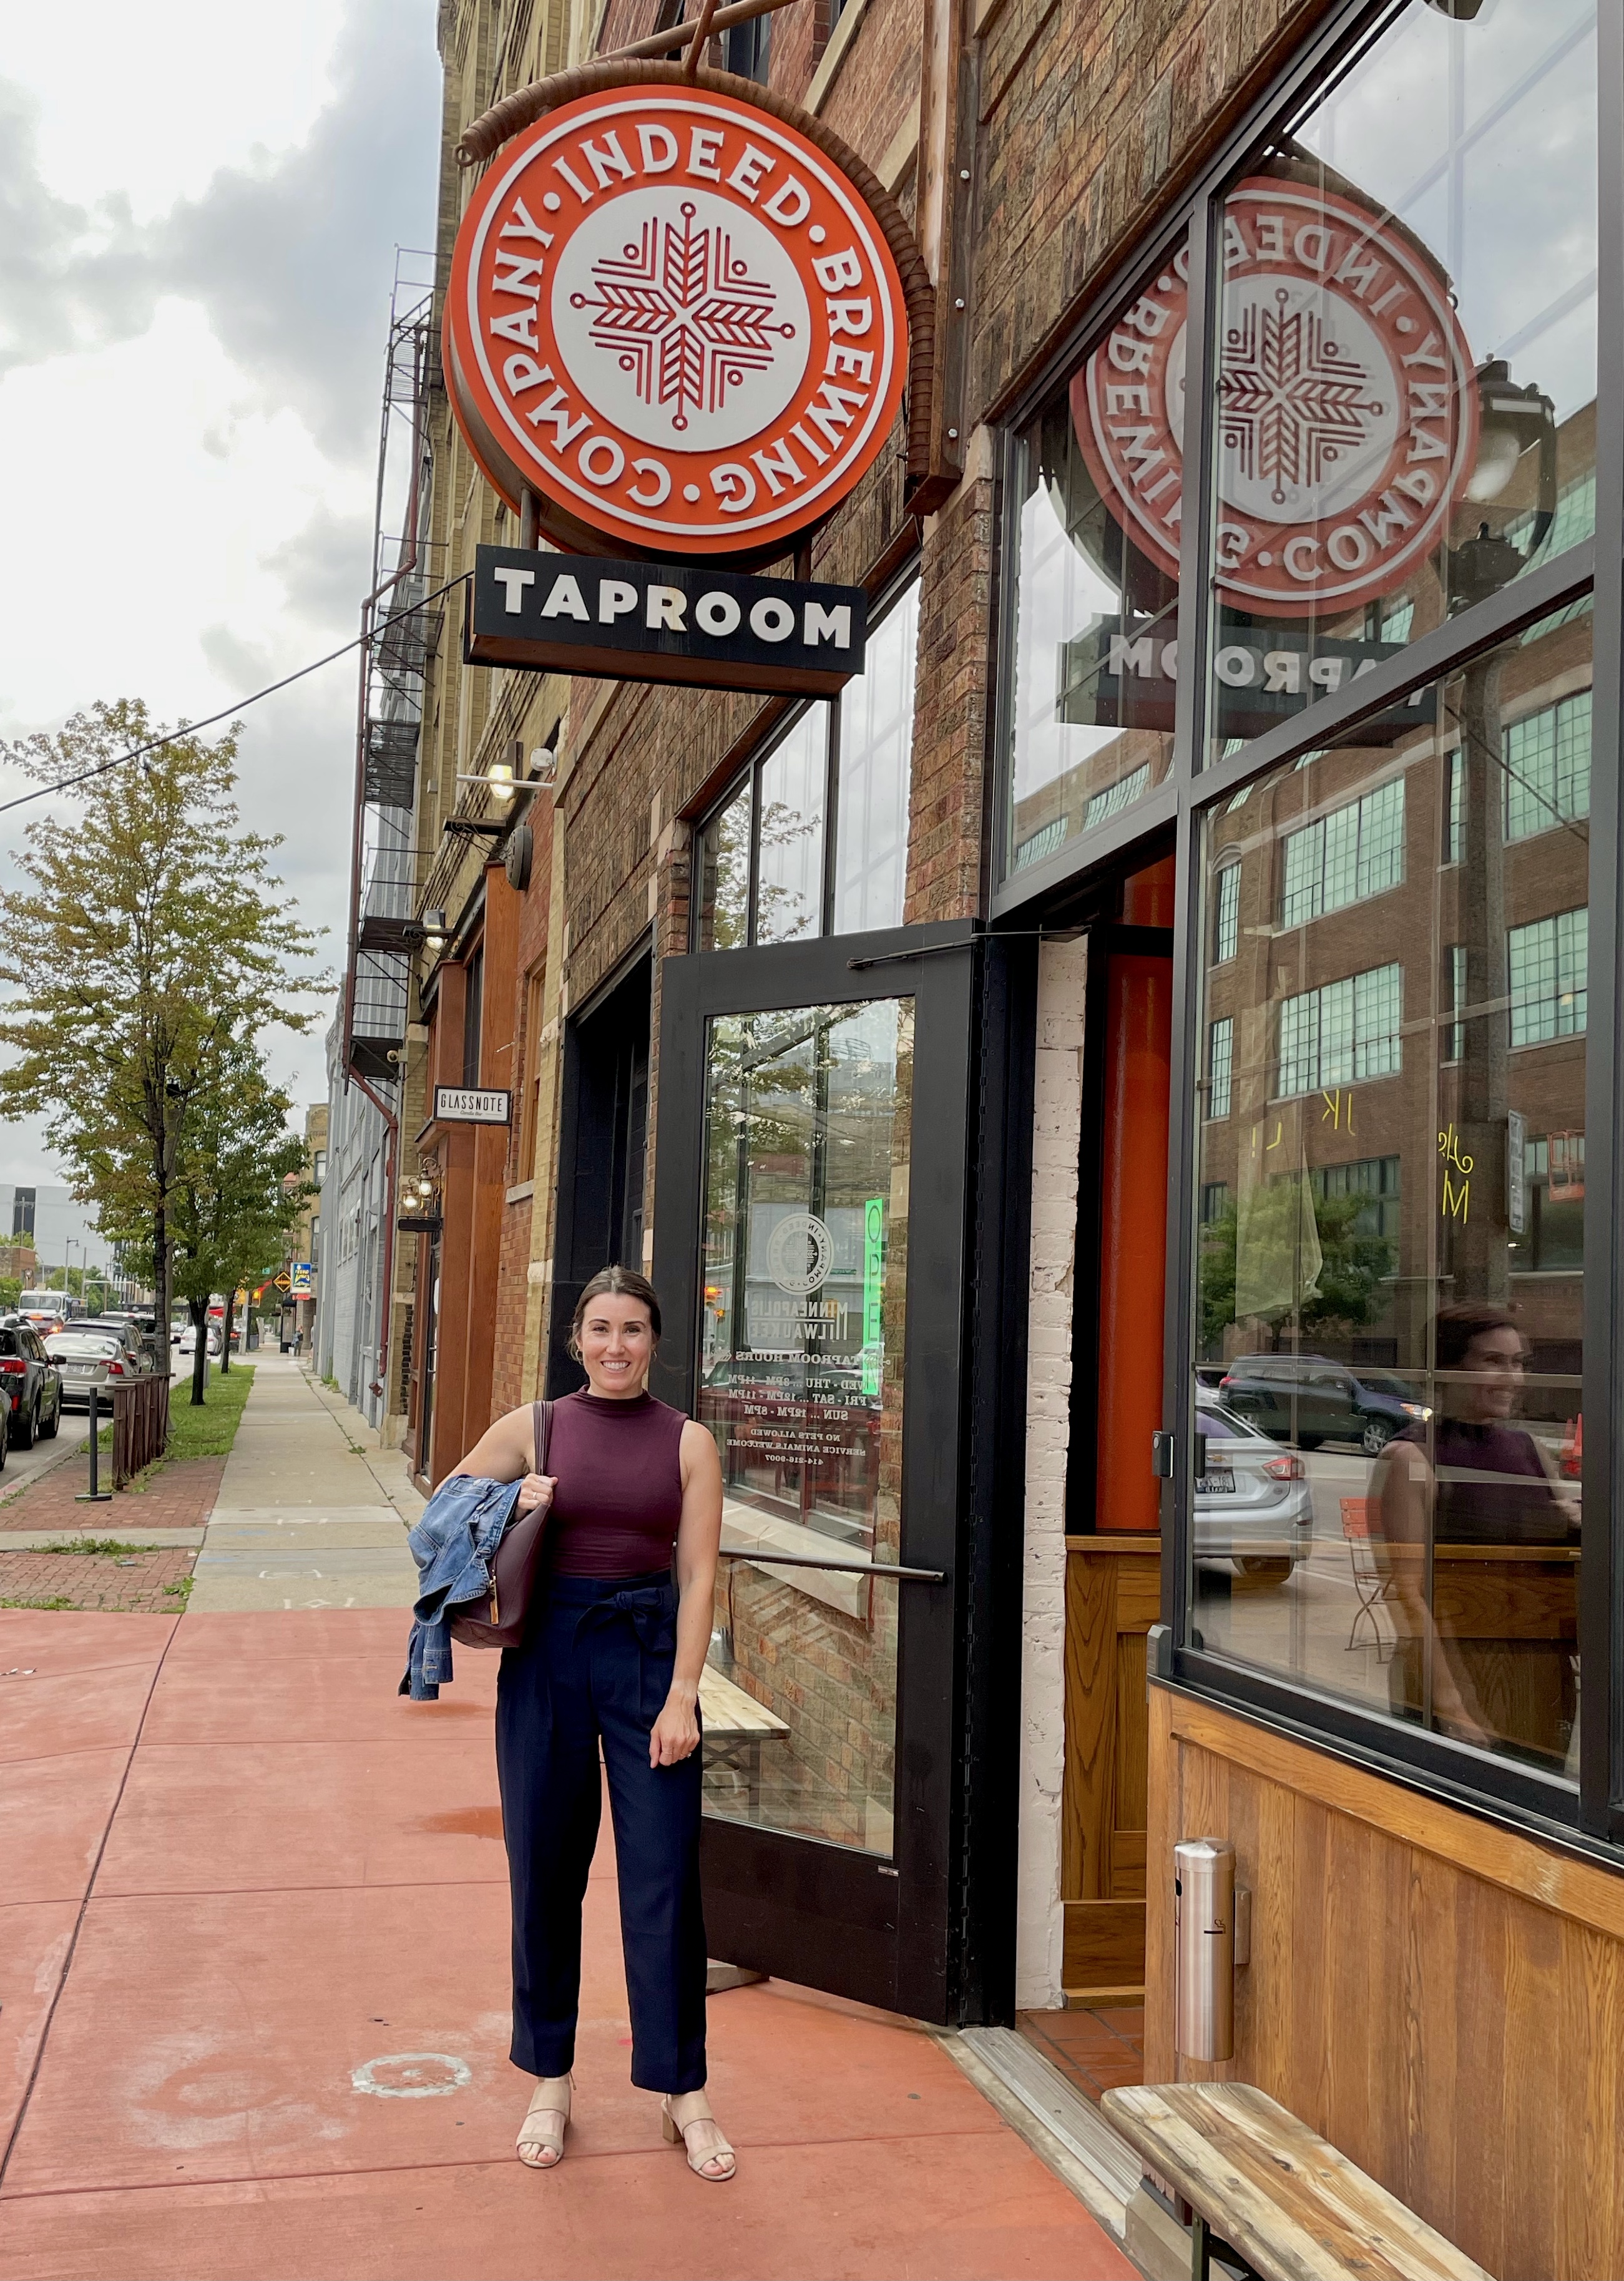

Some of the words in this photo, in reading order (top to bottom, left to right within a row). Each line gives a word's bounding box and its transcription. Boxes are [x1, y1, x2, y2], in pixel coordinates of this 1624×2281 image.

[551, 124, 812, 228] INDEED
[489, 195, 672, 507] COMPANY
[710, 245, 873, 513] BREWING
[494, 566, 851, 649] TAPROOM
[441, 1093, 502, 1112] GLASSNOTE
